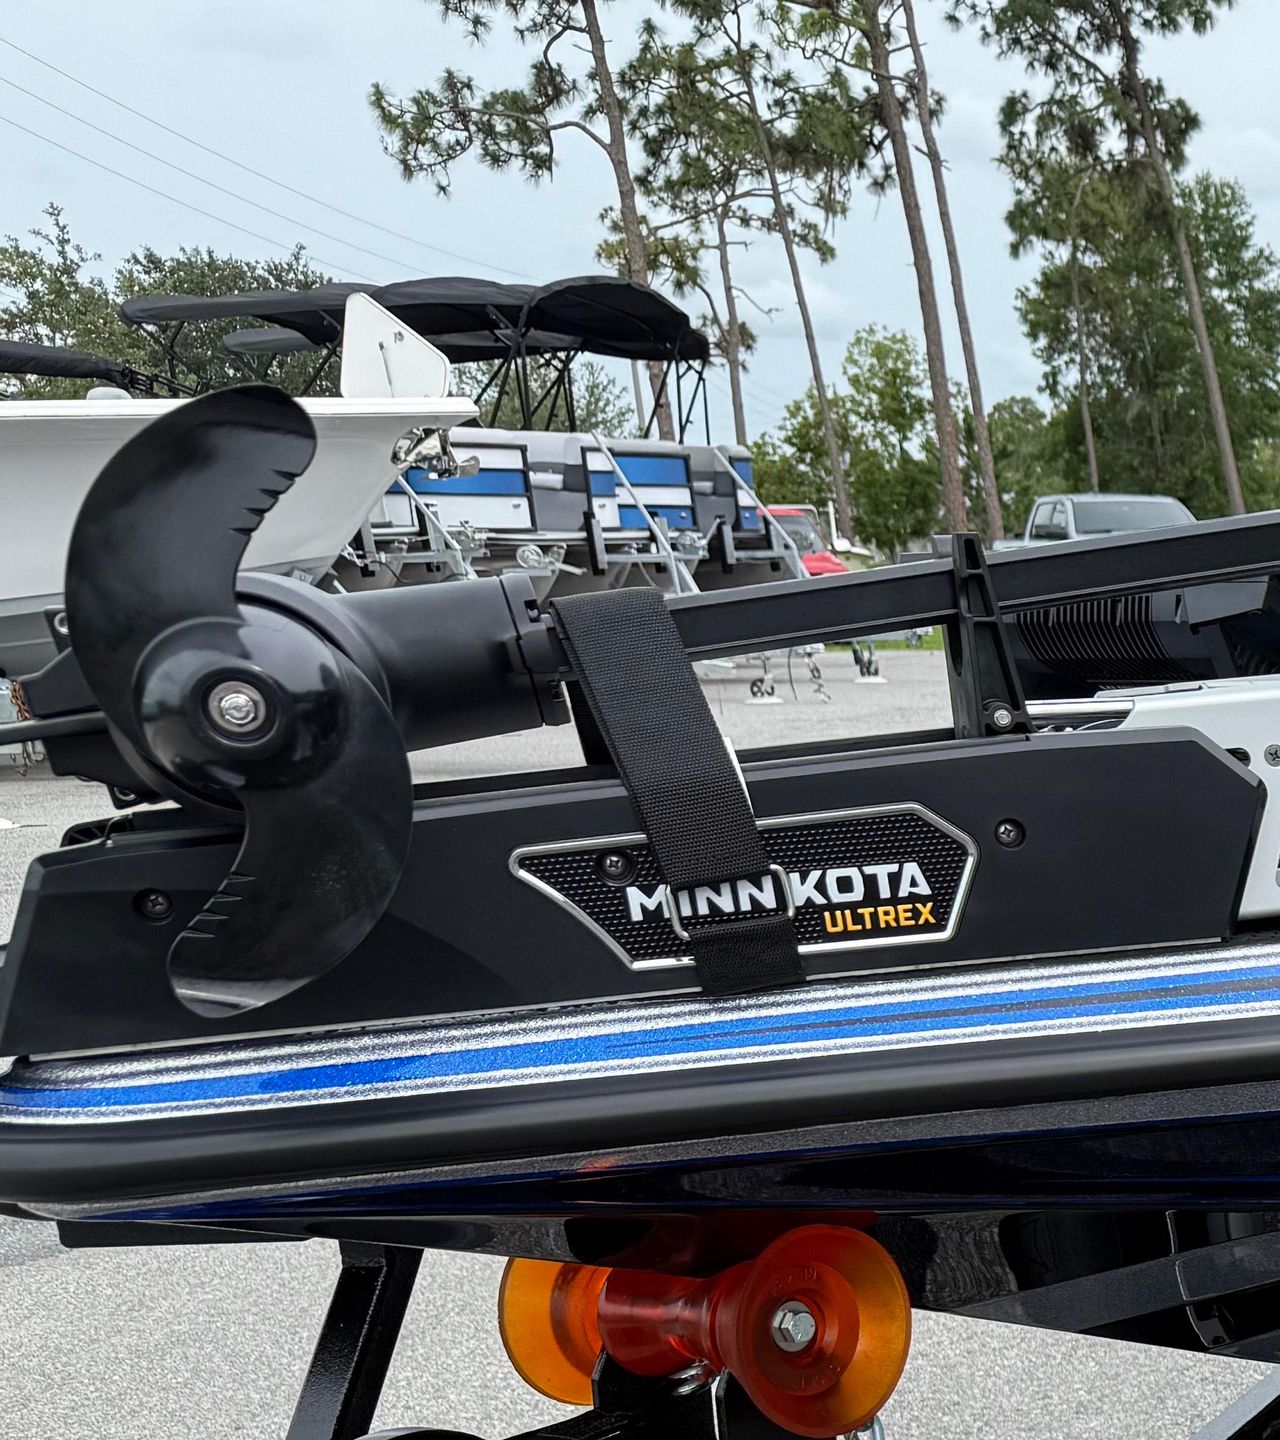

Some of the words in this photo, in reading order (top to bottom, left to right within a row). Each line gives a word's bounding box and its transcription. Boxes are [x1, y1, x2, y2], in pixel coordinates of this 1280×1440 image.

[626, 874, 777, 922] MINN
[788, 862, 933, 907] KOTA
[823, 903, 937, 934] ULTREX
